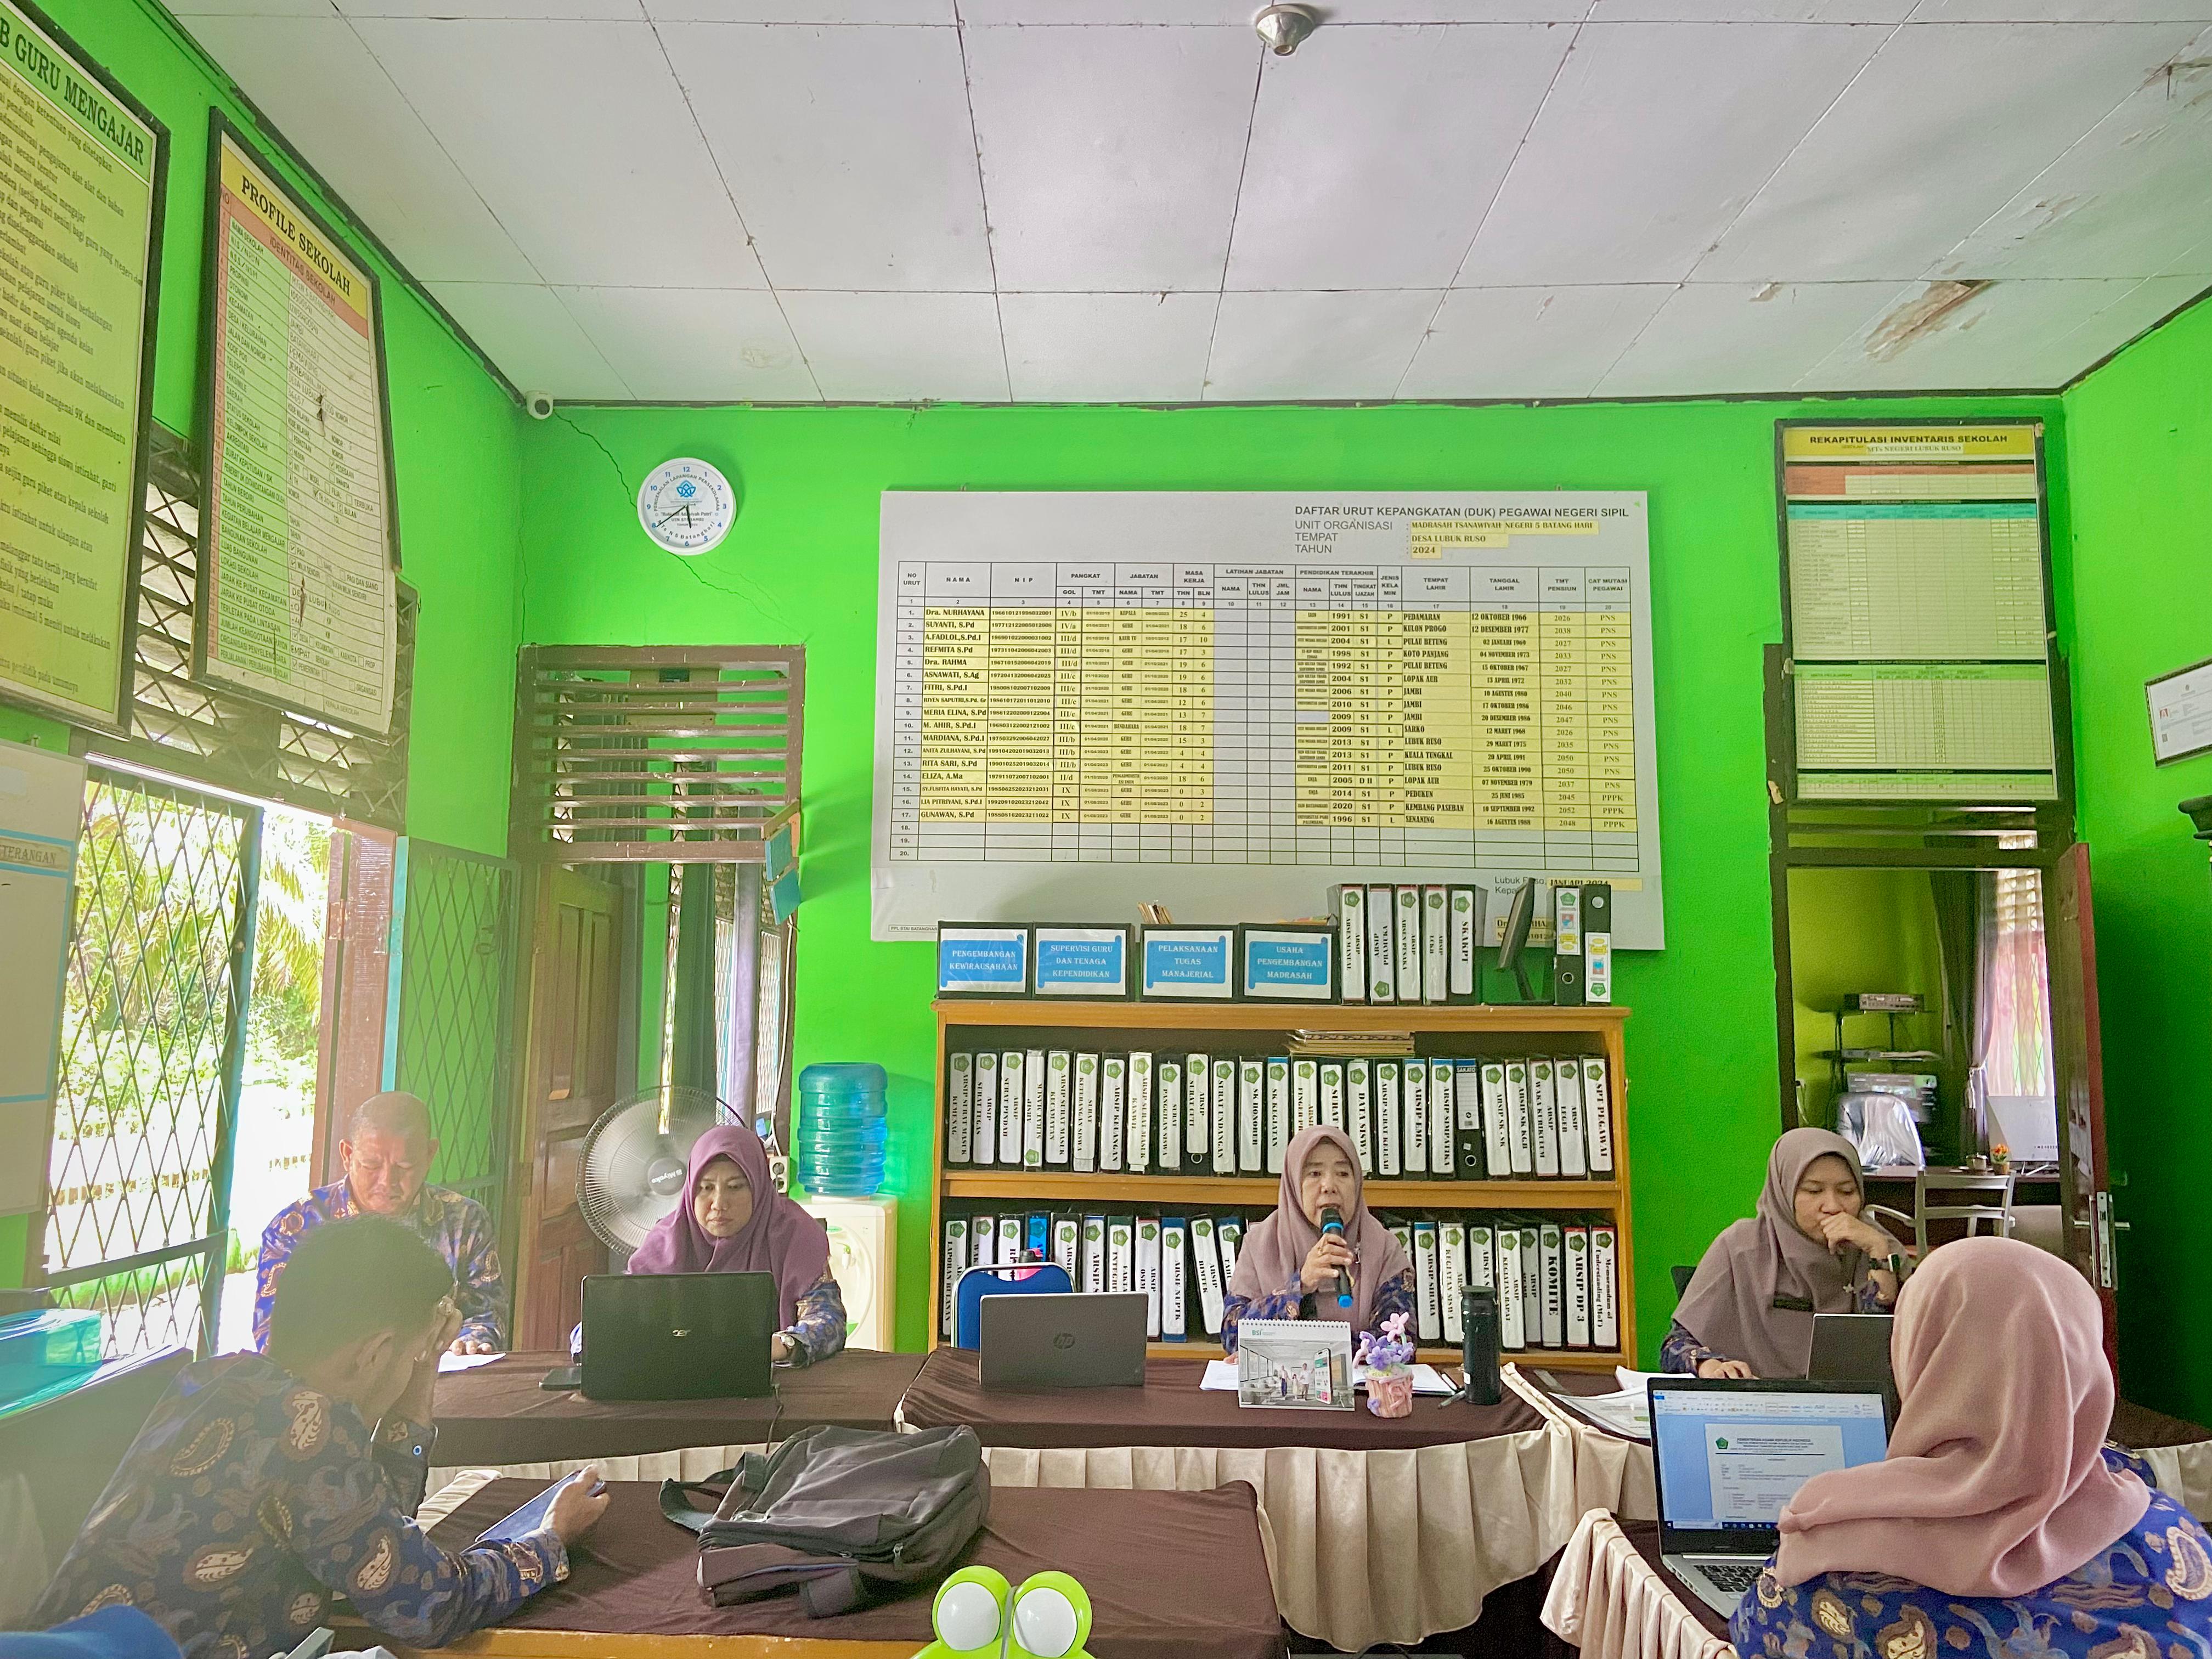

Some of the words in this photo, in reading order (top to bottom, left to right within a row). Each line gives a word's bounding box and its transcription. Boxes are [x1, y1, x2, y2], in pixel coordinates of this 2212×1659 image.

[15, 34, 60, 91] GURU
[64, 75, 143, 165] MENGAJAR
[232, 221, 243, 238] NAMA
[244, 230, 263, 255] SEKOLAH
[242, 175, 296, 241] PROFILE
[299, 233, 350, 296] SEKOLAH
[270, 236, 304, 274] IDENTITAS
[306, 270, 335, 305] SEKOLAH
[239, 349, 247, 363] POS
[223, 493, 236, 507] TAHUN
[236, 500, 264, 523] PERUBAHAN
[1295, 506, 1339, 515] DAFTAR
[1344, 507, 1374, 515] URUT
[1377, 507, 1460, 516] KEPANGKATAN
[1465, 508, 1496, 517] (DUK)
[1499, 508, 1550, 517] PEGAWAI
[1555, 508, 1597, 517] NEGERI
[1601, 509, 1629, 517] SIPIL
[222, 509, 241, 524] KEGIATAN
[242, 517, 261, 535] BELAJAR
[262, 528, 285, 548] MENGAJAR
[1295, 521, 1320, 529] UNIT
[1324, 521, 1392, 530] ORGANISASI
[1295, 533, 1338, 541] TEMPAT
[1295, 544, 1332, 553] TAHUN
[1406, 804, 1435, 812] KEMBANG
[1436, 804, 1464, 812] PASEBAN
[950, 962, 1018, 970] KEWIRAUSAHAAN
[1257, 958, 1322, 967] PENGEMBANGAN
[1161, 970, 1214, 978] MANAJERIAL
[1267, 971, 1312, 979] MADRASAH
[1252, 1088, 1259, 1099] SK
[1596, 1083, 1604, 1104] SPT
[1520, 1116, 1527, 1128] SK
[1597, 1107, 1607, 1158] PEGAWAI
[651, 1171, 676, 1183] Miyako
[1199, 1260, 1208, 1294] BIMTEK
[1575, 1254, 1583, 1291] ARSIP
[1548, 1256, 1558, 1316] KOMITE
[1576, 1295, 1584, 1312] DP
